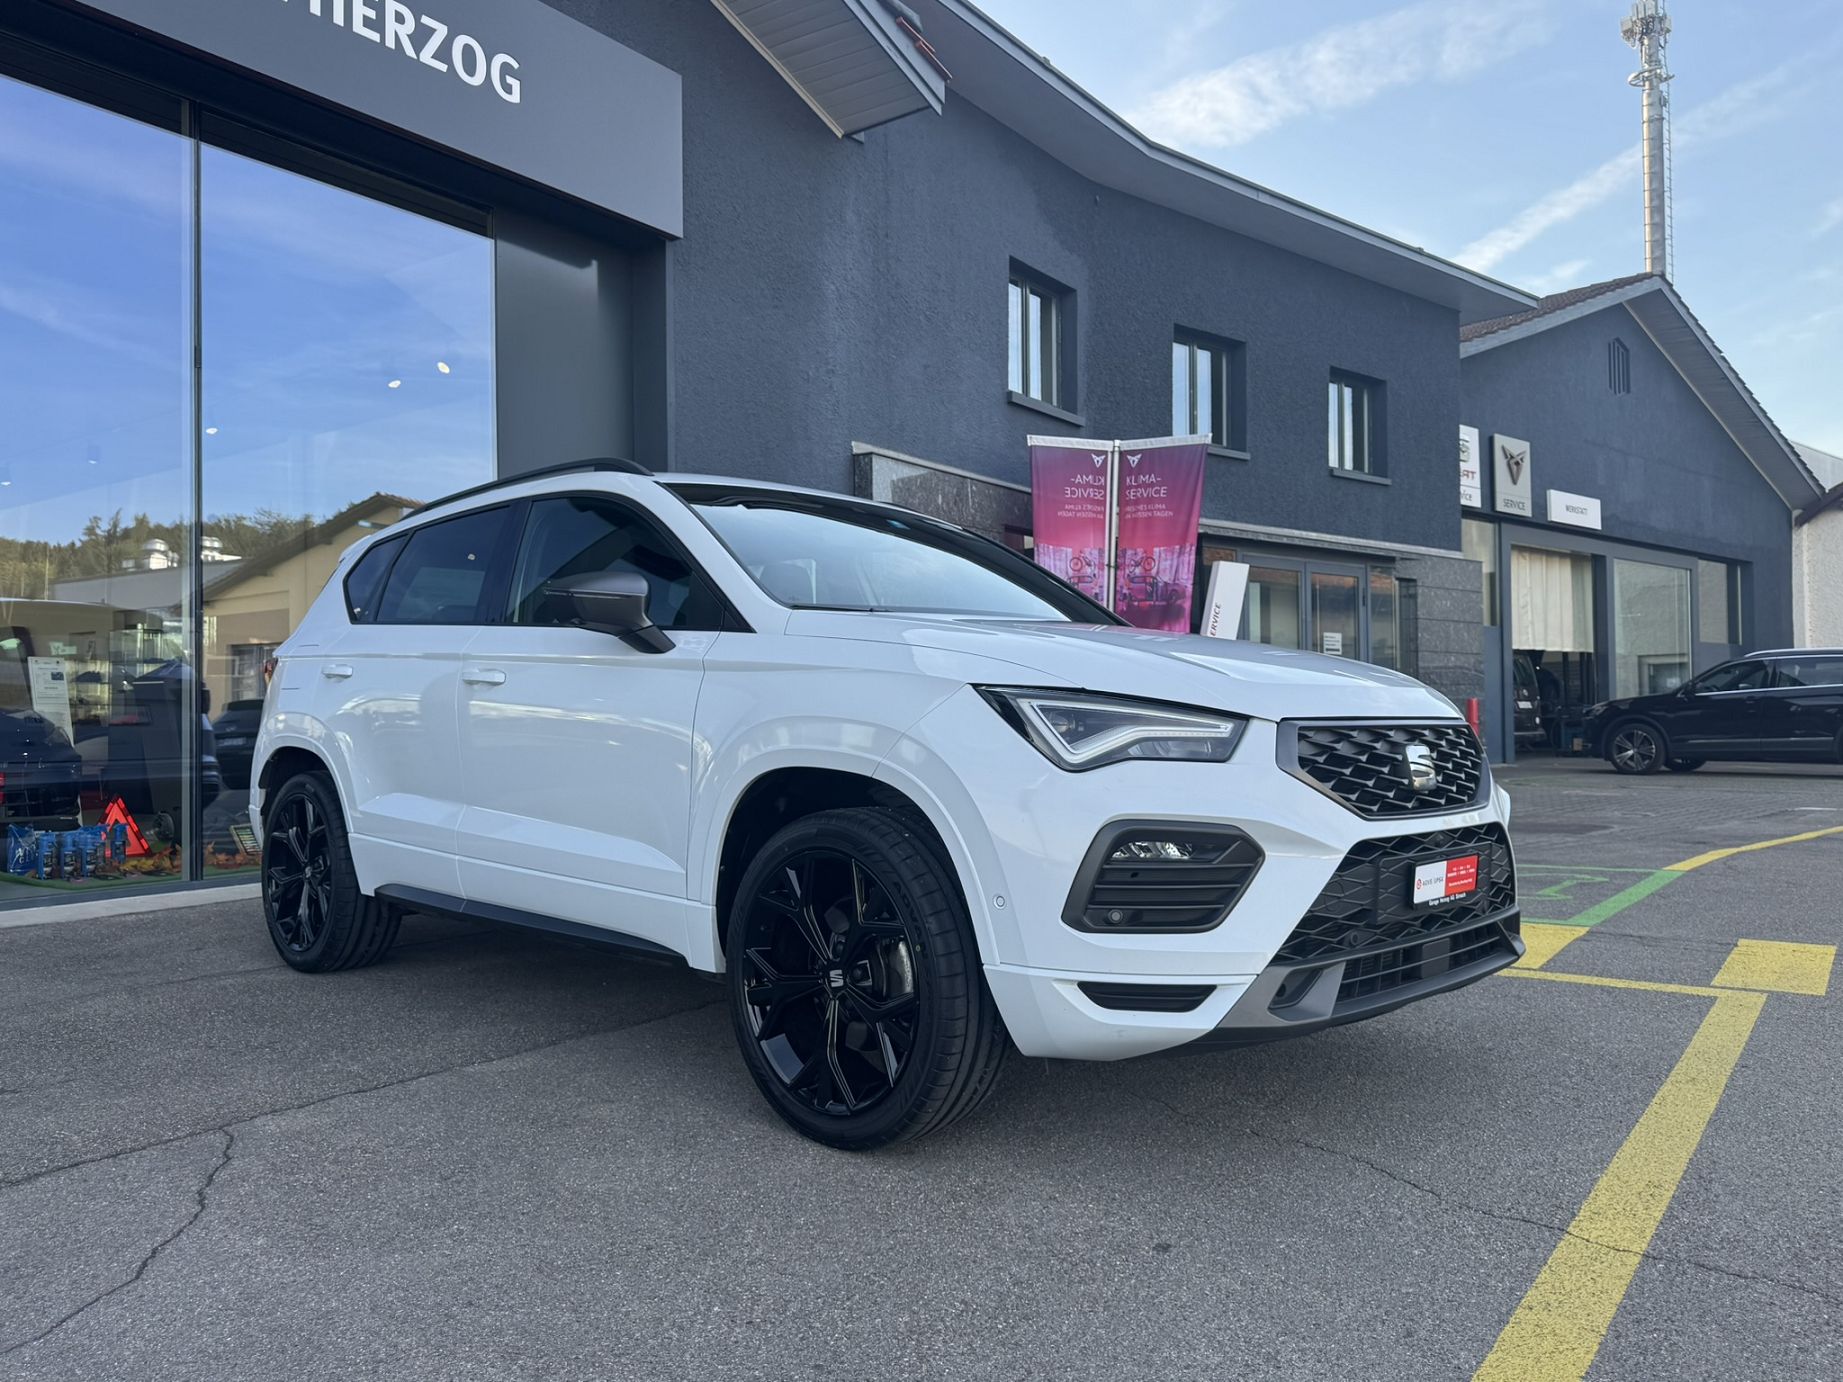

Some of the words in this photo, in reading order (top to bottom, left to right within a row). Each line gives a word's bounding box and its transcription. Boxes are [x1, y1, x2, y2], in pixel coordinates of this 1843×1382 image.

[1126, 473, 1162, 486] KLIMA-
[1126, 486, 1168, 500] SERVICE
[1503, 498, 1526, 511] SERVICE
